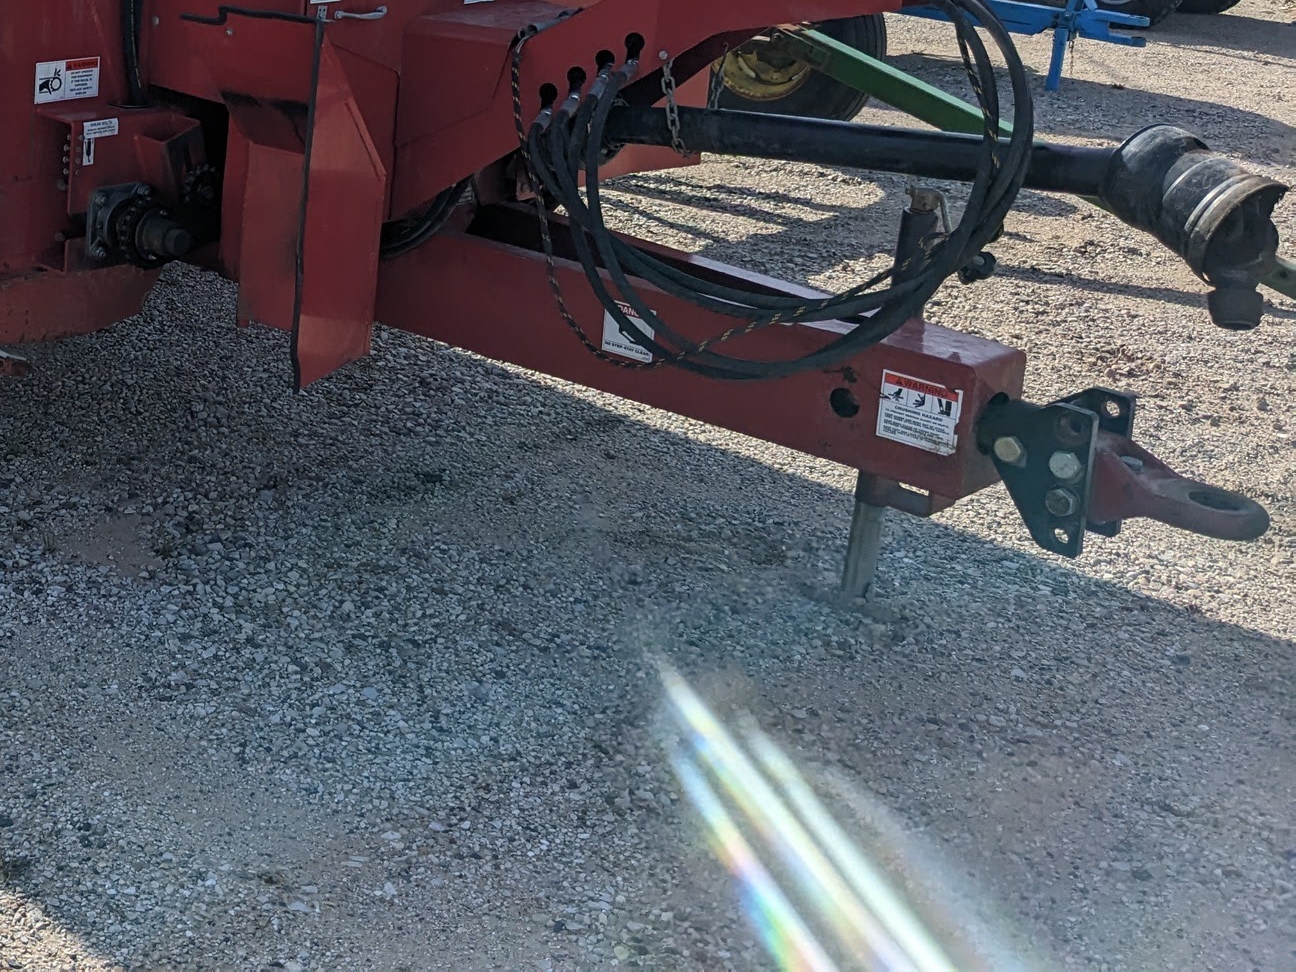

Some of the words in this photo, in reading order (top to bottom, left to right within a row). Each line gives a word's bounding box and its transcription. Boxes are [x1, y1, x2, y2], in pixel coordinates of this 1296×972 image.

[904, 378, 948, 398] WARNING
[894, 405, 921, 416] CRUSHING
[921, 413, 943, 422] HAZARD
